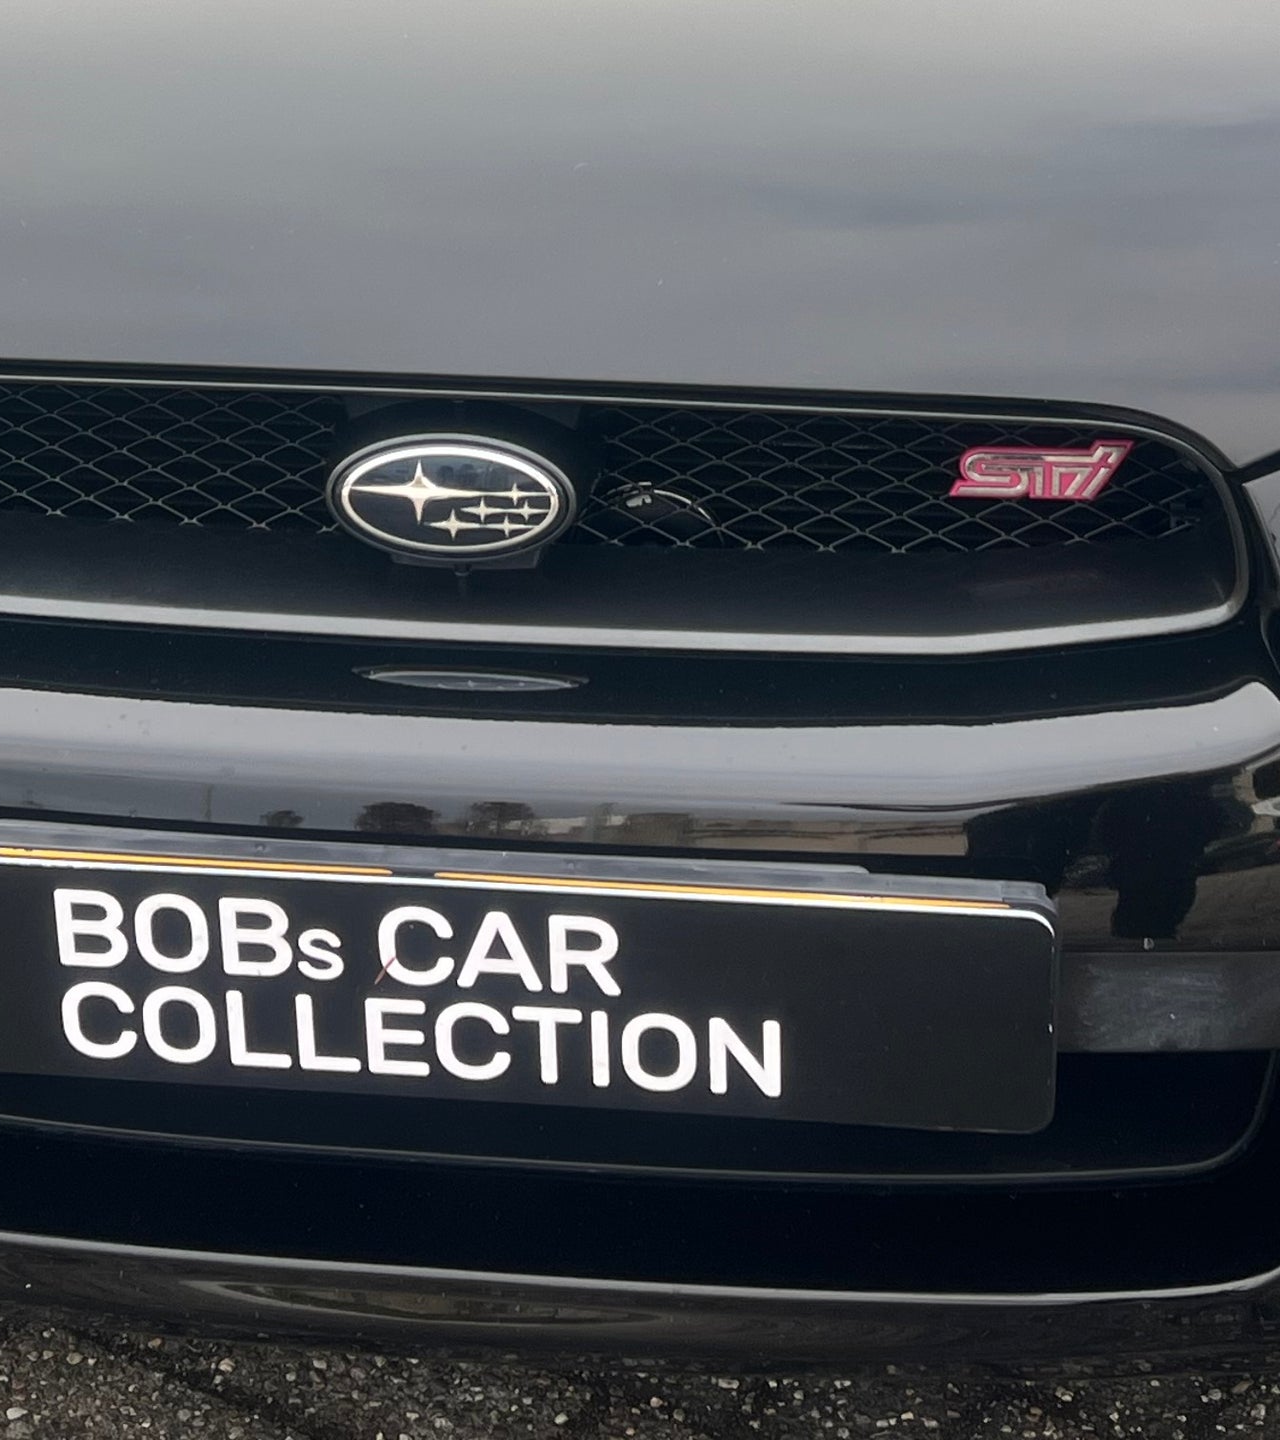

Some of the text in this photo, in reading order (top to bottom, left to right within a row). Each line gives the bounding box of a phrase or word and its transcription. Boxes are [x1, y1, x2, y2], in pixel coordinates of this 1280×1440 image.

[53, 888, 622, 996] BOBs CAR
[61, 981, 782, 1098] COLLECTION
